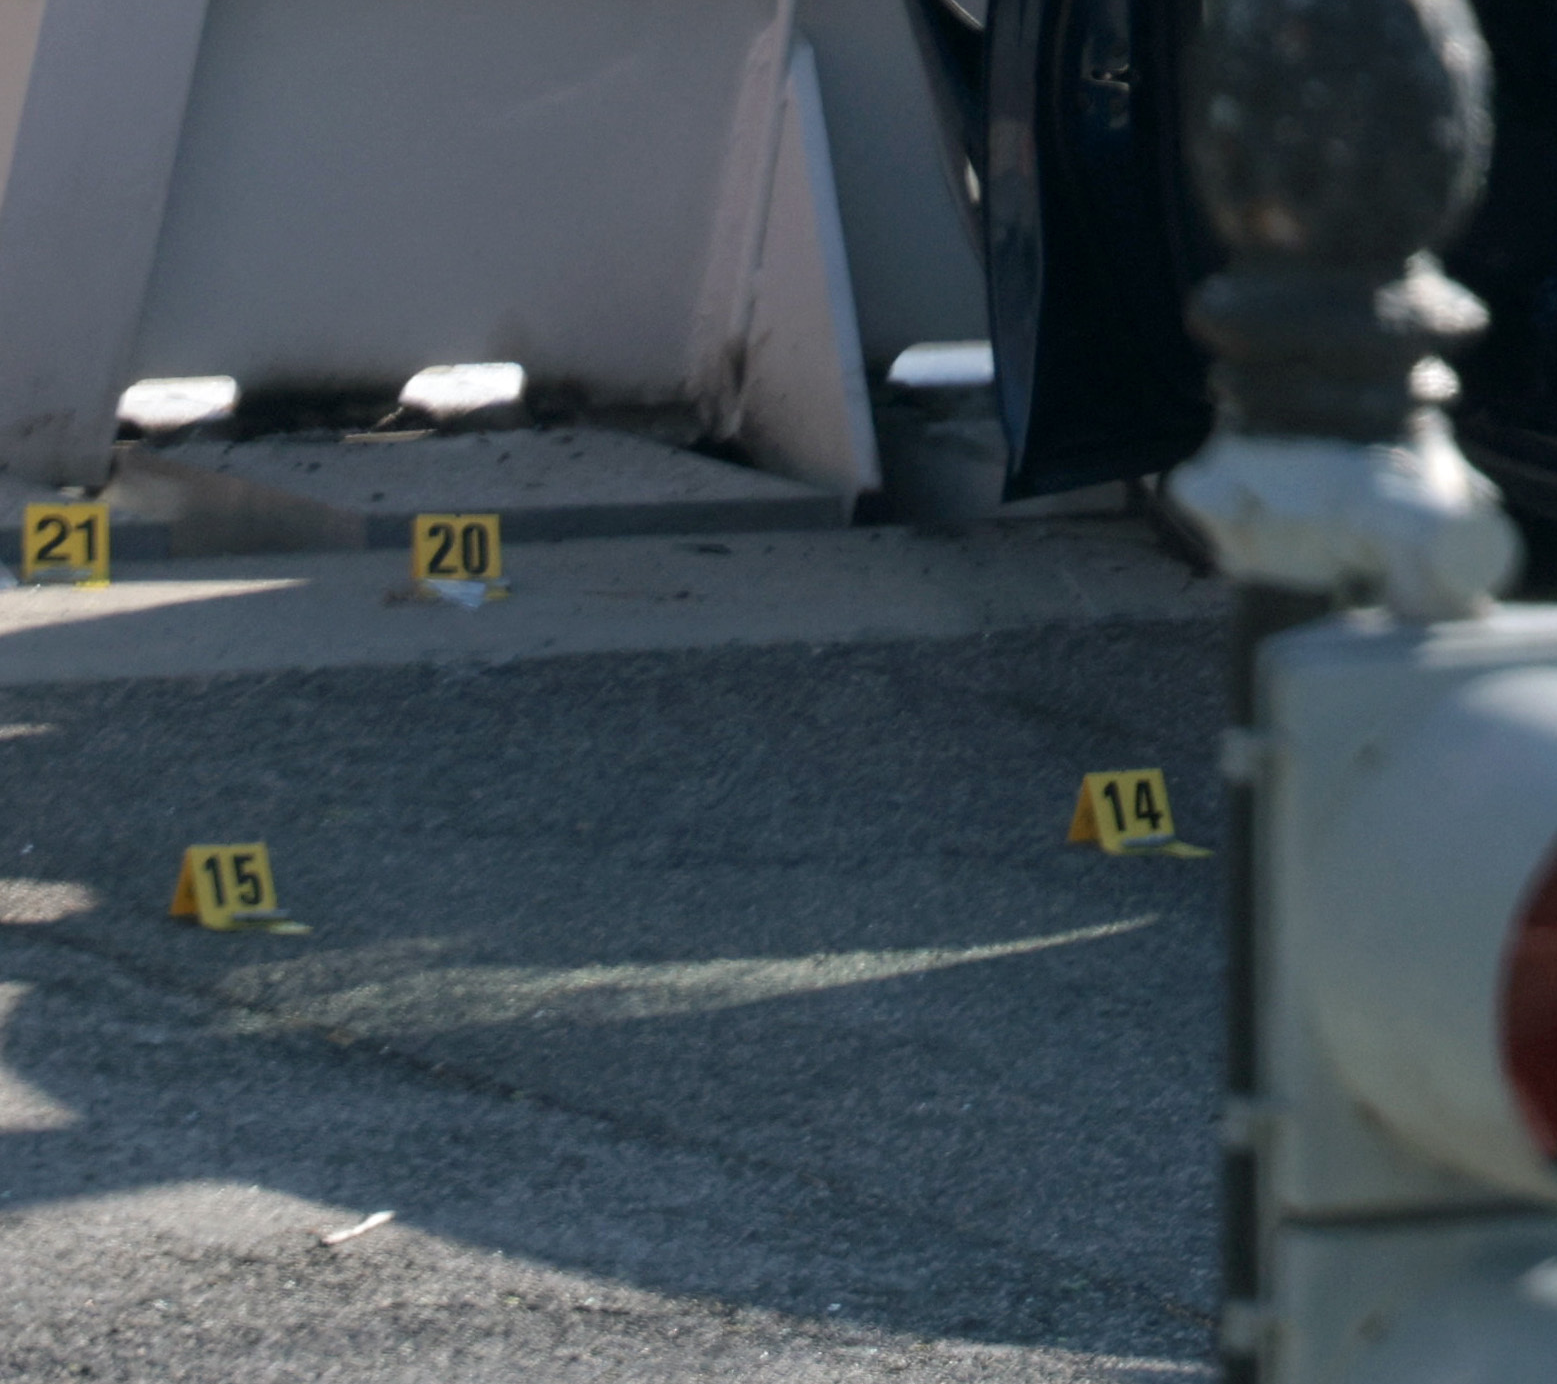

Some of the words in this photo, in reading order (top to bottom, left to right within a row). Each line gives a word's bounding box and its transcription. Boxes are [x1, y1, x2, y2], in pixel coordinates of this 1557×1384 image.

[36, 516, 97, 561] 21
[428, 522, 489, 575] 20
[1103, 779, 1163, 832] 14
[204, 854, 264, 907] 15
